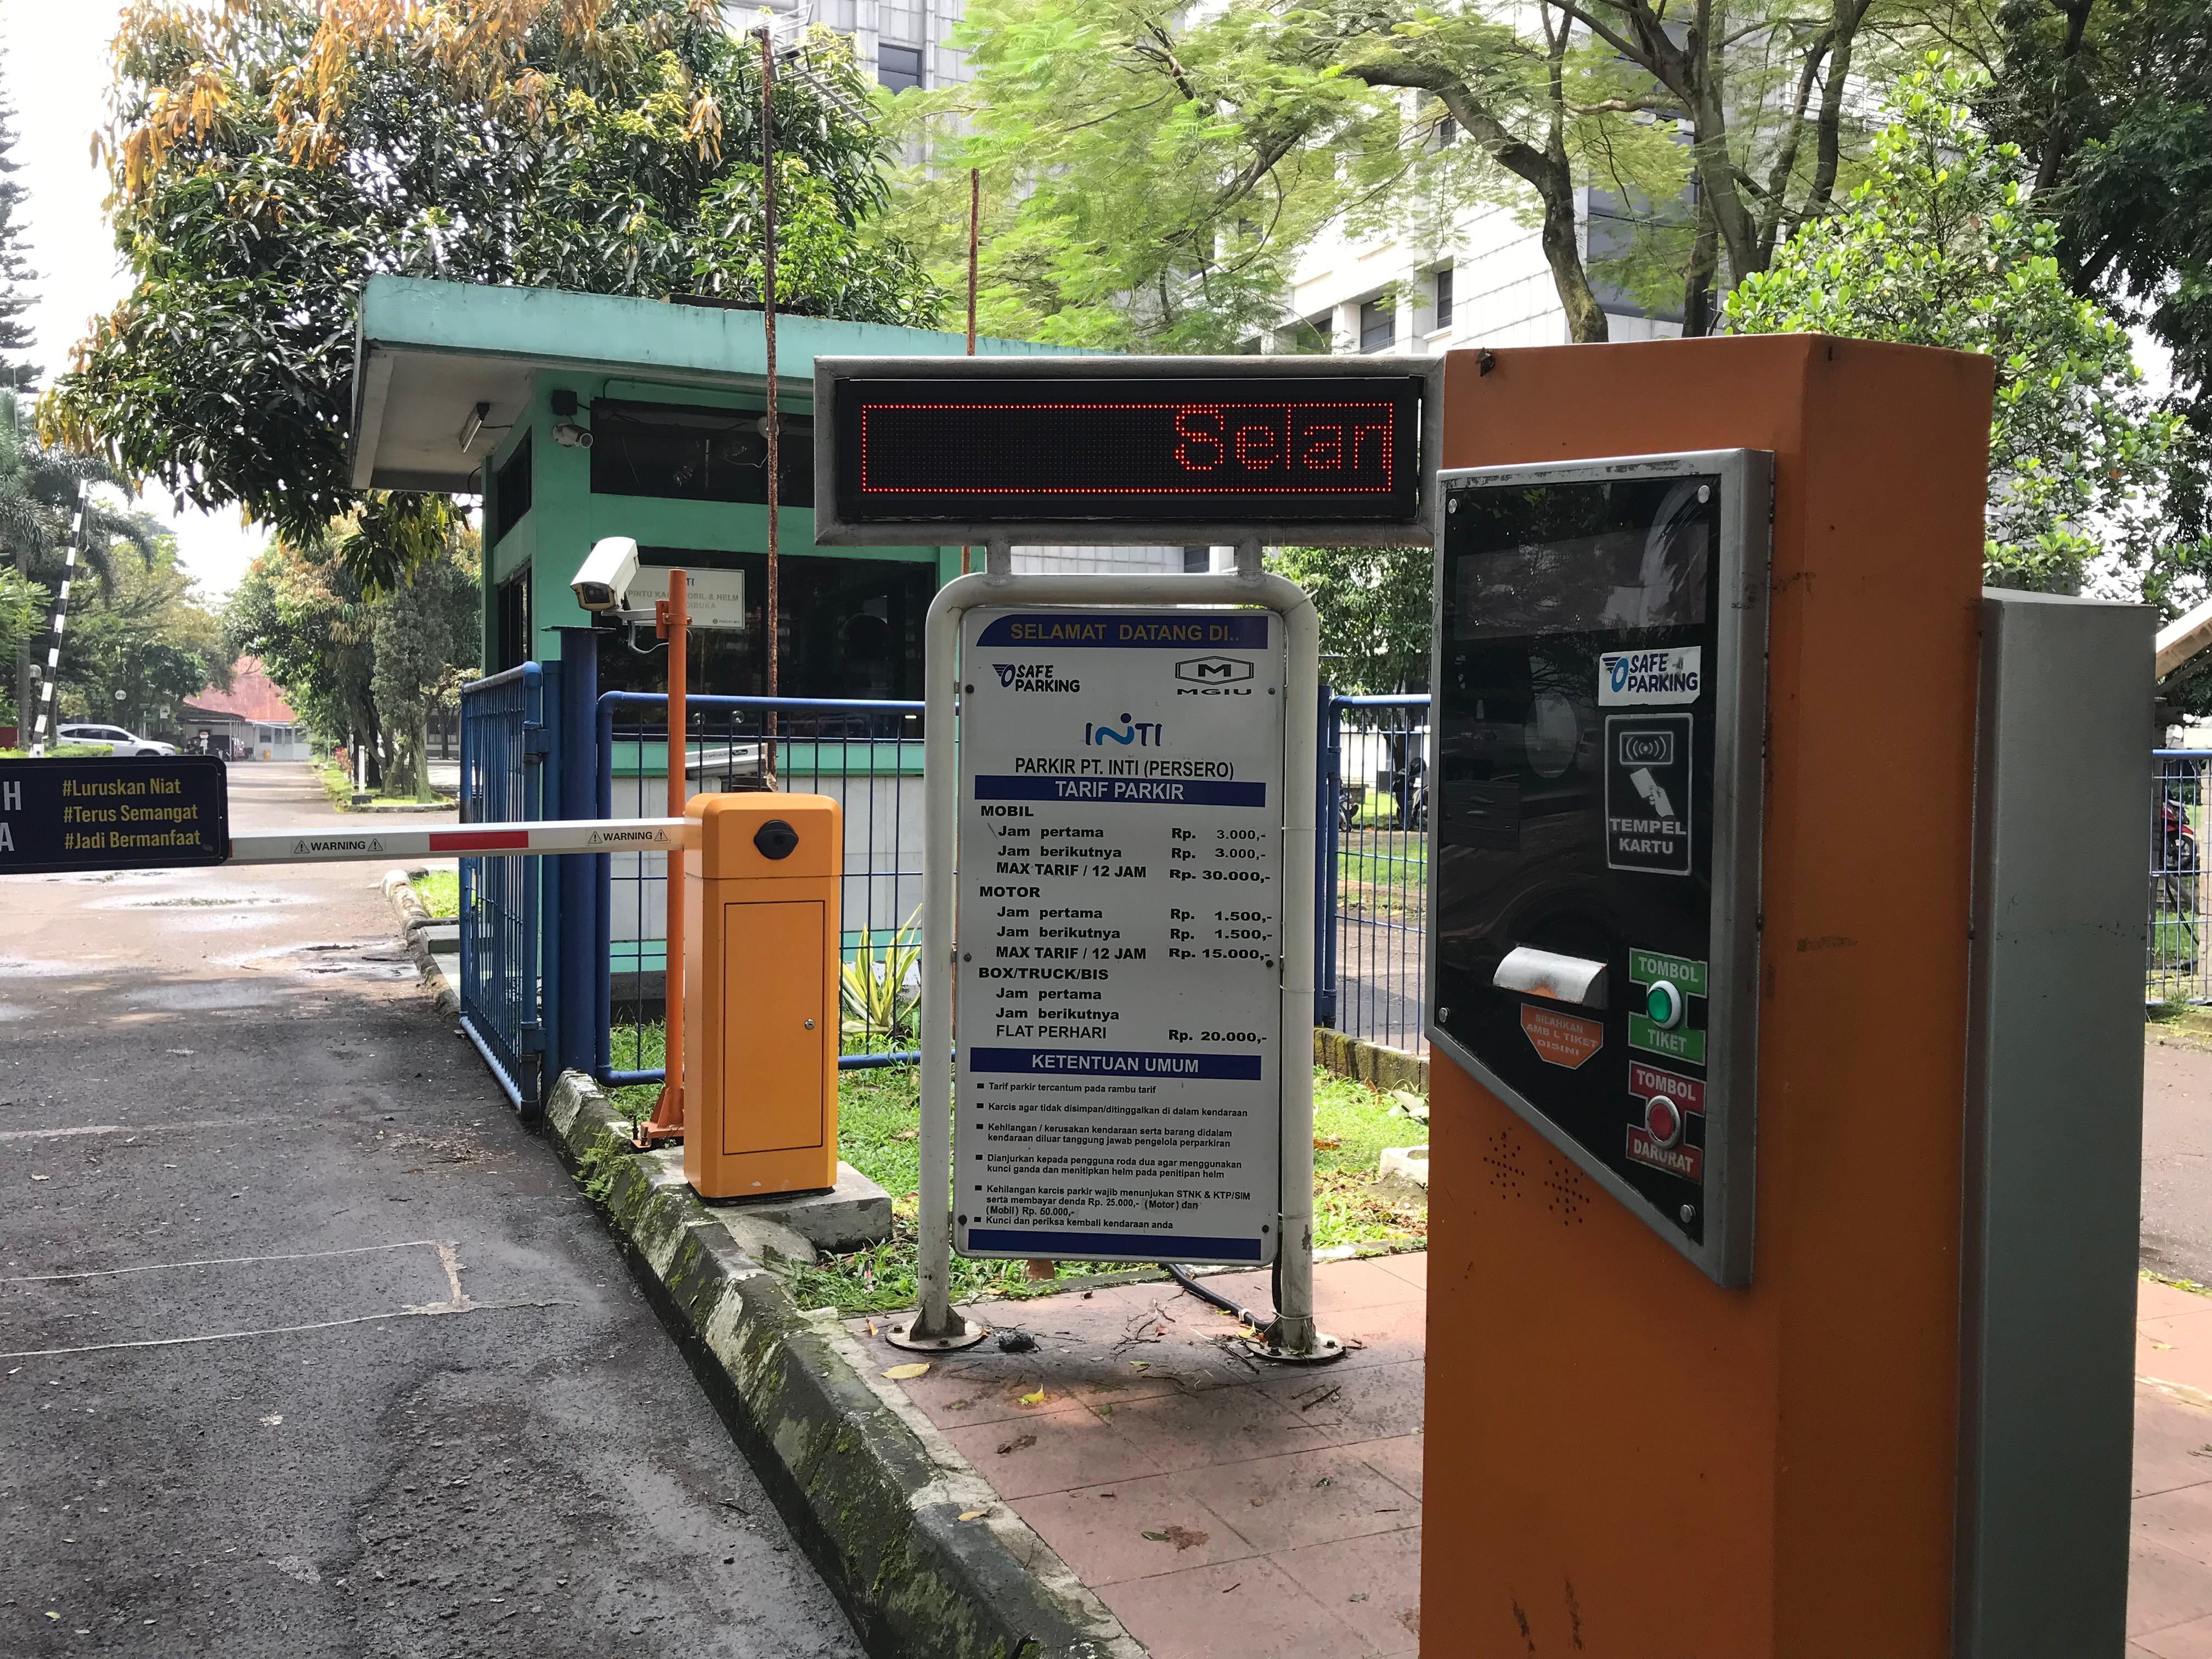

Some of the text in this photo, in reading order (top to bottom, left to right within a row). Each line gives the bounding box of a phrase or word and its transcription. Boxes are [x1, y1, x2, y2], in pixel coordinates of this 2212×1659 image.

[1011, 624, 1107, 639] SELAMAT
[1120, 625, 1201, 640] DATANG
[1017, 664, 1053, 678] SAFE
[1629, 653, 1669, 674] SAFE
[1015, 679, 1080, 692] PARKING
[1628, 672, 1698, 693] PARKING
[1085, 713, 1163, 746] INTI
[1016, 758, 1233, 780] PARKIR PT. INTI (PERSERO)
[63, 778, 180, 796] #Luruskan Niat
[1056, 781, 1183, 799] TARIF PARKIR
[64, 804, 198, 822] #Terus Semangat
[981, 806, 1034, 816] MOBIL
[998, 826, 1266, 841] Jam pertama Rp. 3.000,-
[1610, 819, 1686, 834] TEMPEL
[65, 830, 200, 849] #Jadi Bermanfaat
[603, 832, 652, 840] WARNING
[311, 841, 365, 850] WARNING
[998, 845, 1265, 861] Jam berikutnya Rp. 3.000,-
[1620, 838, 1673, 854] KARTU
[997, 862, 1030, 874] MAX
[1035, 864, 1079, 876] TARIF
[1093, 865, 1109, 877] 12
[1115, 866, 1146, 877] JAM
[1170, 870, 1196, 881] Rp.
[1203, 871, 1270, 883] 30.000,-
[980, 887, 1040, 898] MOTOR
[997, 906, 1272, 923] Jam pertama Rp. 1.500,-
[997, 926, 1272, 941] Jam berikutnya Rp. 1.500,-
[996, 946, 1030, 958] MAX
[1035, 947, 1078, 958] TARIF
[1093, 948, 1109, 959] 12
[1114, 949, 1146, 959] JAM
[1169, 949, 1195, 960] Rp.
[1203, 949, 1269, 961] 15.000,-
[979, 968, 1108, 980] BOX/TRUCK/BIS
[1639, 957, 1698, 982] TOMBOL
[996, 988, 1101, 1001] Jam pertama
[996, 1007, 1119, 1022] Jam berikutnya
[1536, 1014, 1583, 1033] SILAHKAN
[997, 1025, 1266, 1044] FLAT PERHARI Rp. 20.000,-
[1564, 1033, 1597, 1047] TIKET
[1648, 1029, 1686, 1052] TIKET
[1537, 1039, 1579, 1056] DISINI
[1032, 1055, 1198, 1072] KETENTUAN UMUM
[1011, 1083, 1036, 1092] parkir
[1085, 1085, 1105, 1093] pada
[1637, 1069, 1696, 1101] TOMBOL
[1064, 1105, 1159, 1115] disimpan/ditinggalkan
[1202, 1108, 1247, 1116] kendaraan
[989, 1124, 1036, 1133] Kehilangan
[1092, 1126, 1137, 1134] kendaraan
[1165, 1127, 1194, 1137] barang
[1198, 1128, 1232, 1137] didalam
[988, 1133, 1032, 1142] kendaraan
[1063, 1136, 1104, 1145] tanggung
[1107, 1136, 1132, 1146] jawab
[1135, 1138, 1177, 1147] pengelola
[1180, 1139, 1230, 1148] perparkiran
[988, 1154, 1034, 1164] Dianjurkan
[1037, 1155, 1068, 1164] kepada
[1180, 1160, 1242, 1169] menggunakan
[1014, 1165, 1040, 1174] ganda
[1062, 1167, 1109, 1176] menitipkan
[1136, 1169, 1156, 1177] pada
[1160, 1170, 1200, 1178] penitipan
[987, 1185, 1035, 1195] Kehilangan
[1067, 1188, 1092, 1196] parkir
[1095, 1188, 1118, 1197] wajib
[1120, 1189, 1173, 1199] menunjukan
[1214, 1192, 1250, 1200] KTP/SIM
[1011, 1197, 1057, 1206] membayar
[1088, 1198, 1102, 1207] Rp.
[1107, 1198, 1139, 1207] 25.000,-
[1145, 1200, 1178, 1210] (Motor)
[1182, 1201, 1199, 1209] dan
[986, 1206, 1074, 1217] (Mobil) Rp. 50.000,-
[1033, 1217, 1064, 1226] periksa
[1067, 1218, 1101, 1226] kembali
[1104, 1220, 1149, 1228] kendaraan
